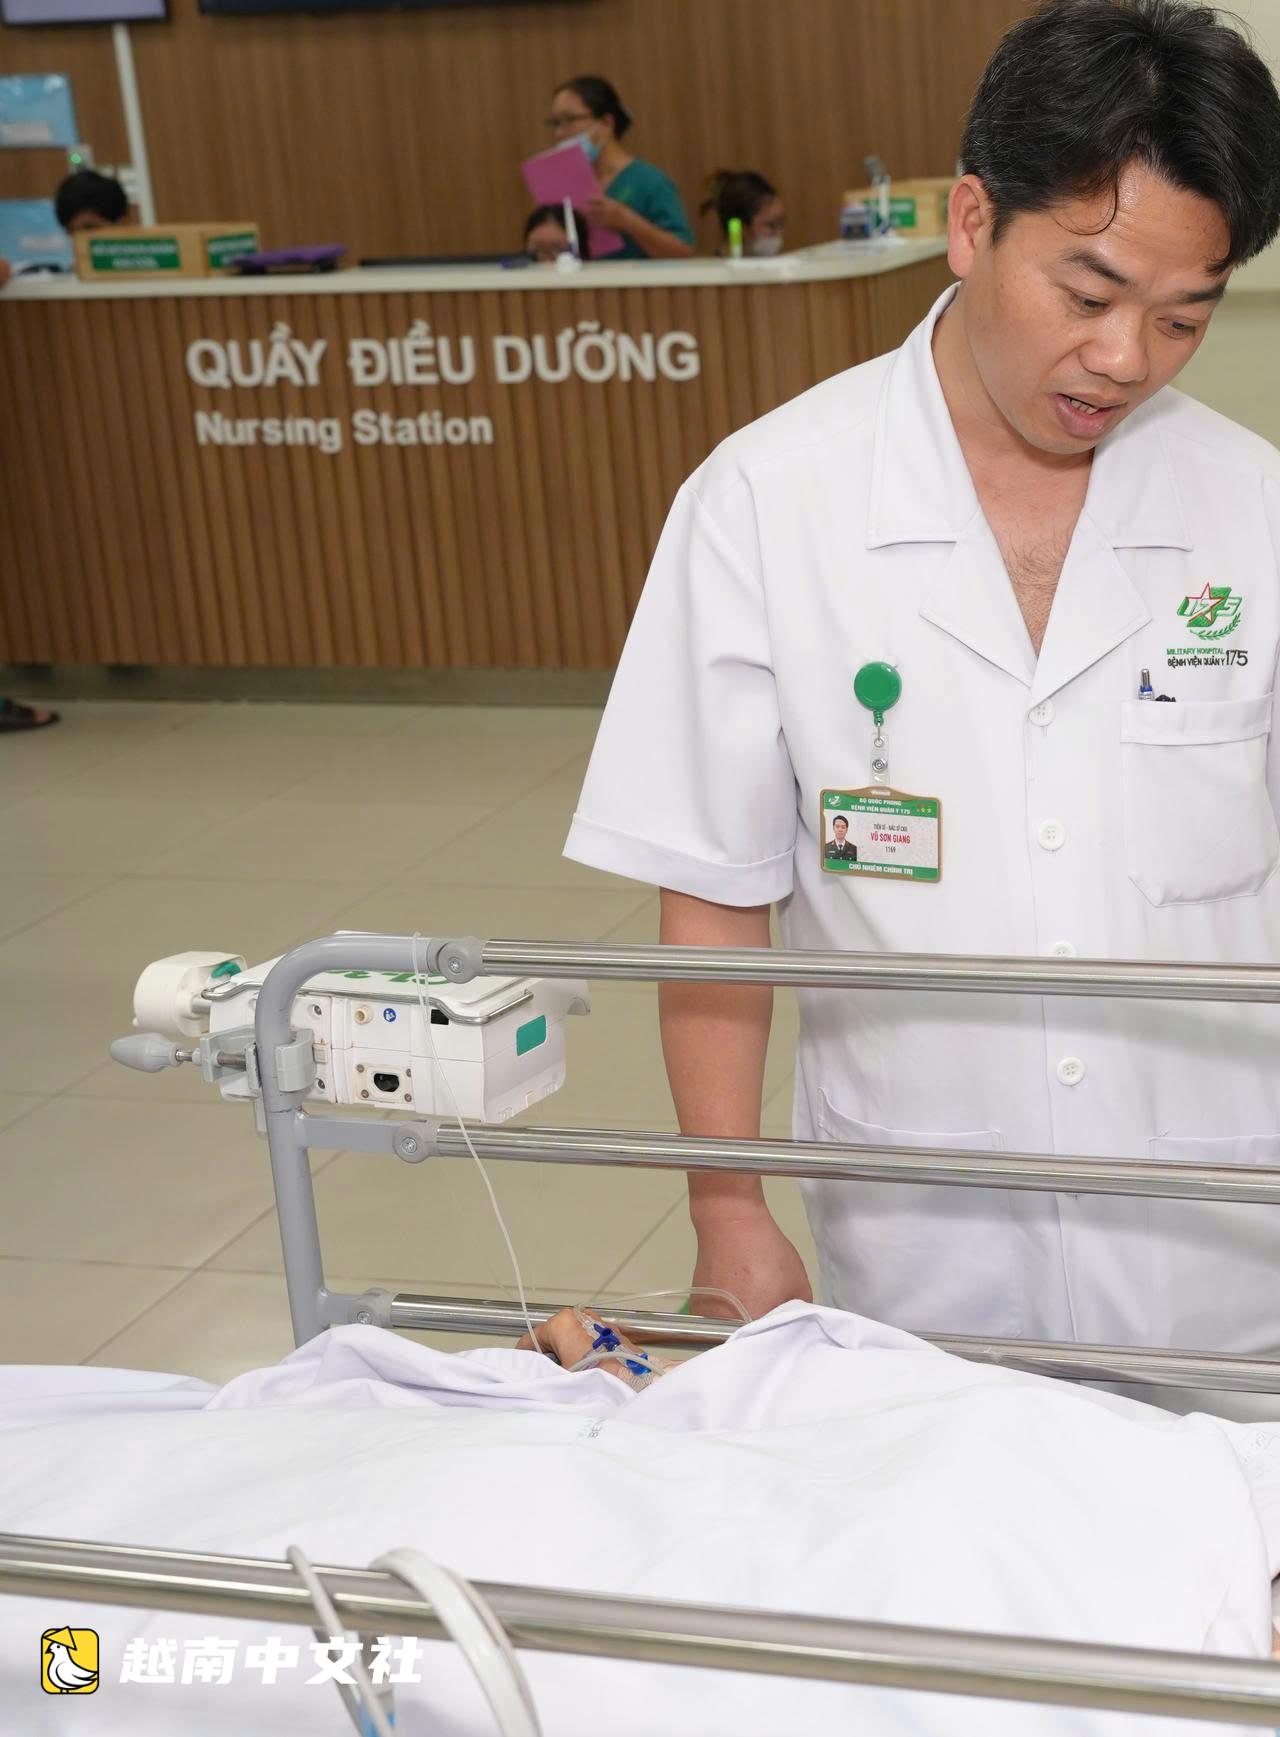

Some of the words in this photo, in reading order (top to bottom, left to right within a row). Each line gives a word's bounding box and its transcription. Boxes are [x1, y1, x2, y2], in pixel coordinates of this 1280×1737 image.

[347, 319, 476, 386] ĐIỀU
[493, 320, 700, 383] DƯỠNG
[194, 410, 343, 454] Nursing
[352, 408, 493, 445] Station
[1168, 656, 1186, 669] BỆNH
[1187, 655, 1202, 668] VIỆN
[1221, 658, 1226, 666] Y
[1226, 649, 1249, 667] 175
[1196, 647, 1225, 655] HOSPITAL
[892, 834, 911, 844] GIANG
